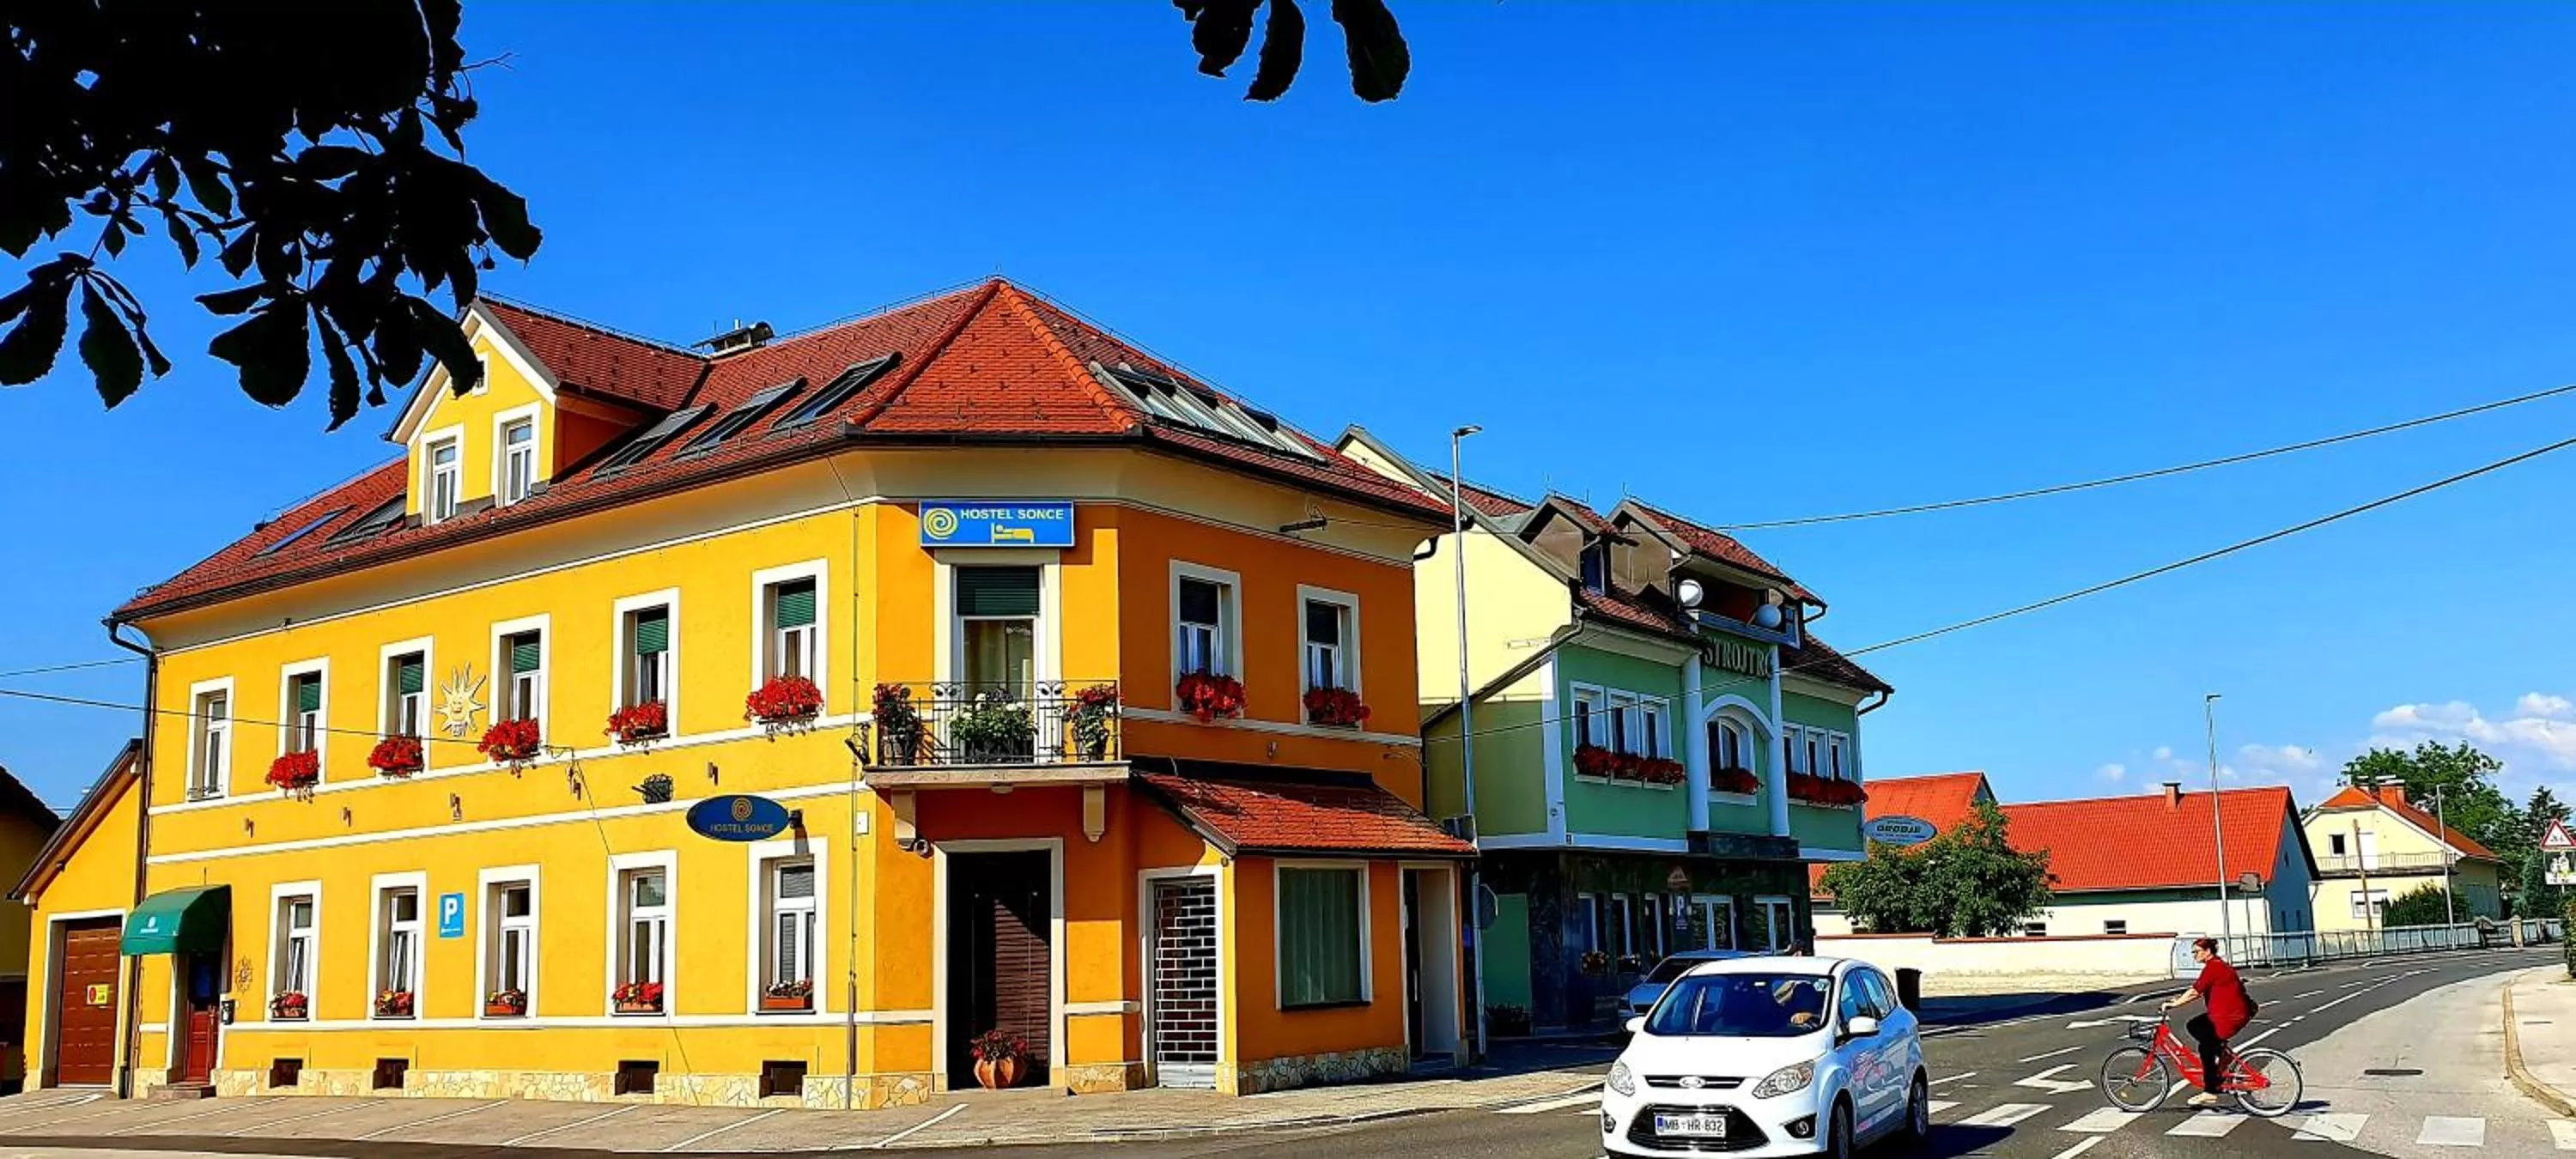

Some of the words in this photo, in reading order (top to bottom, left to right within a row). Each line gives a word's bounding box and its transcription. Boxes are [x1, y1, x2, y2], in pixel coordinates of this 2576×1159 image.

[960, 508, 1014, 519] HOSTEL
[1018, 508, 1065, 519] SONCE
[709, 823, 744, 834] HOSTEL
[744, 823, 774, 834] SONCE
[444, 897, 458, 925] P
